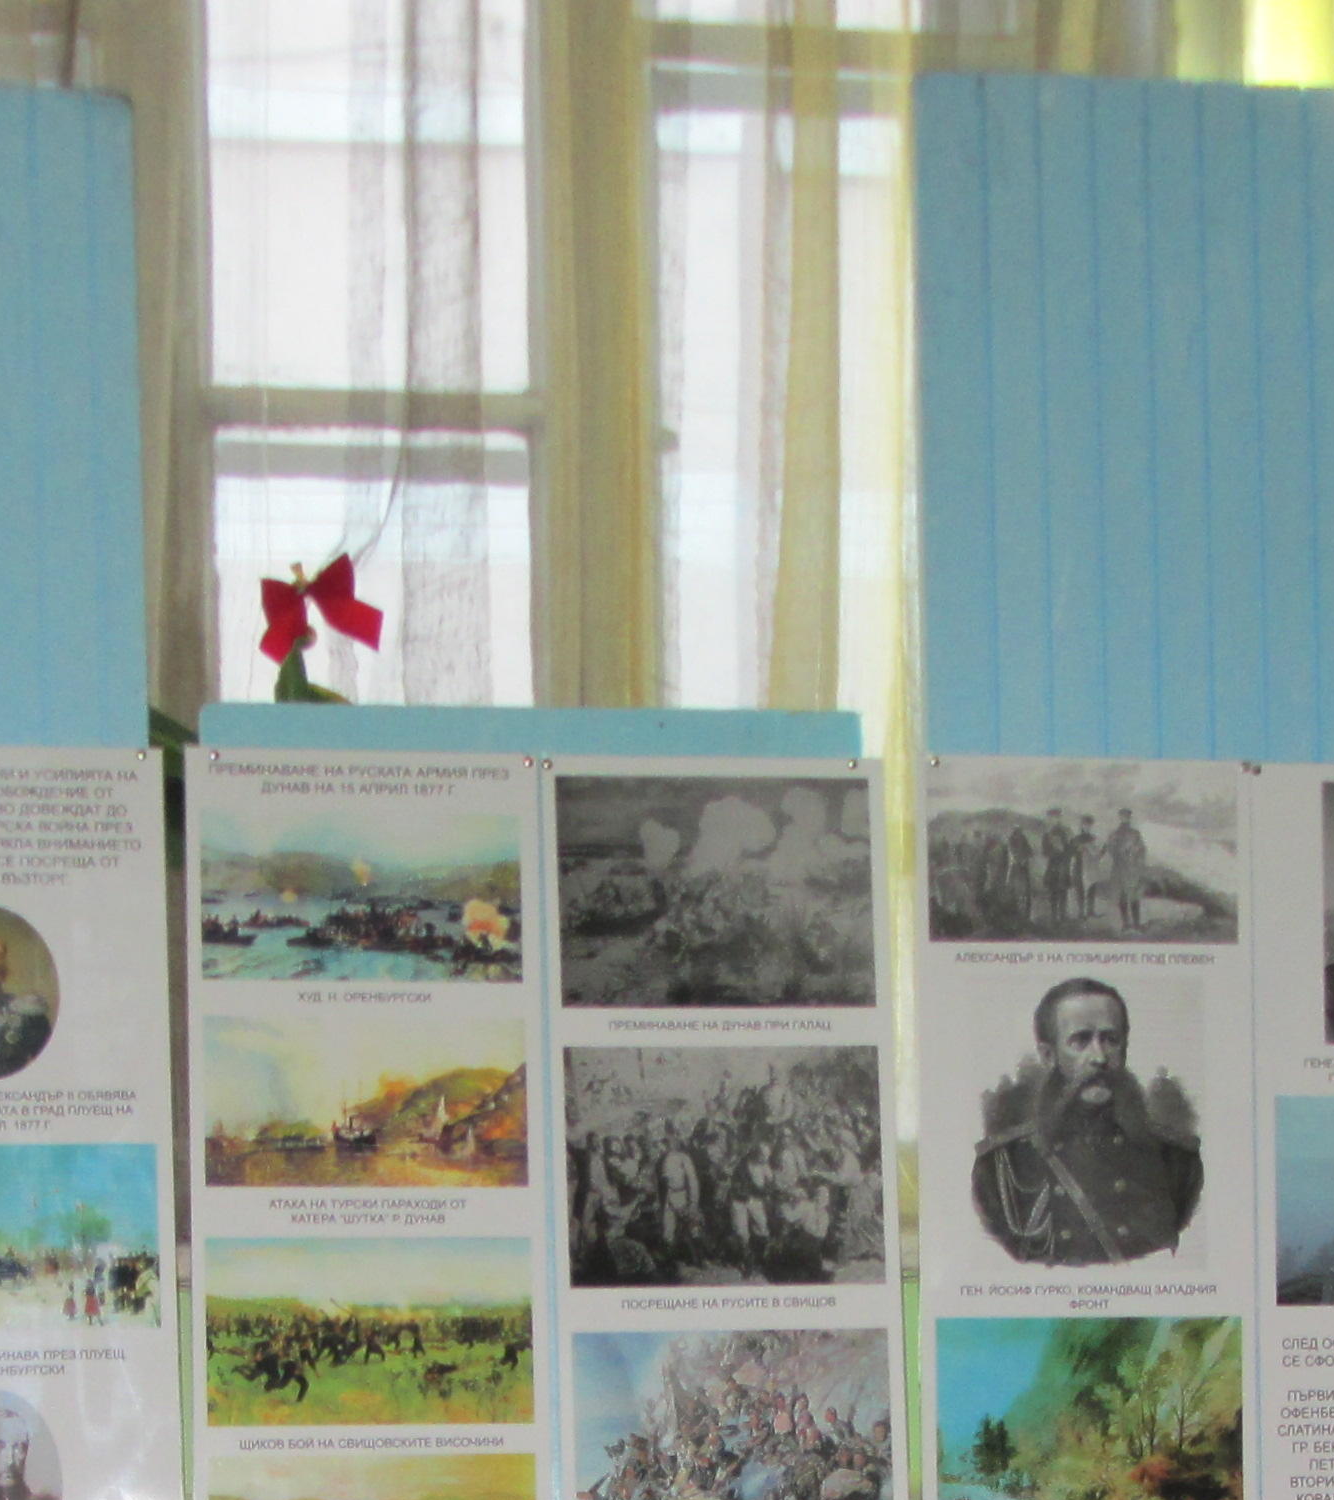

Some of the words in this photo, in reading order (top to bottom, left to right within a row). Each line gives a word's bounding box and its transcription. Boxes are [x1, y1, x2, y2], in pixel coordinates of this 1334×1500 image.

[620, 1297, 698, 1311] ПОСРЕЩАНЕ
[701, 1297, 718, 1308] НА
[721, 1297, 768, 1308] РУСИТЕ
[771, 1296, 780, 1308] В
[783, 1296, 836, 1309] СВИЩОВ
[1281, 1337, 1318, 1351] СЛЕД
[1281, 1354, 1300, 1366] СЕ
[238, 1438, 284, 1451] ЩИКОВ
[287, 1436, 314, 1449] БОЙ
[317, 1438, 334, 1449] НА
[337, 1437, 431, 1450] СВИЩОВСКИТЕ
[435, 1436, 504, 1448] ВИСОЧИНИ
